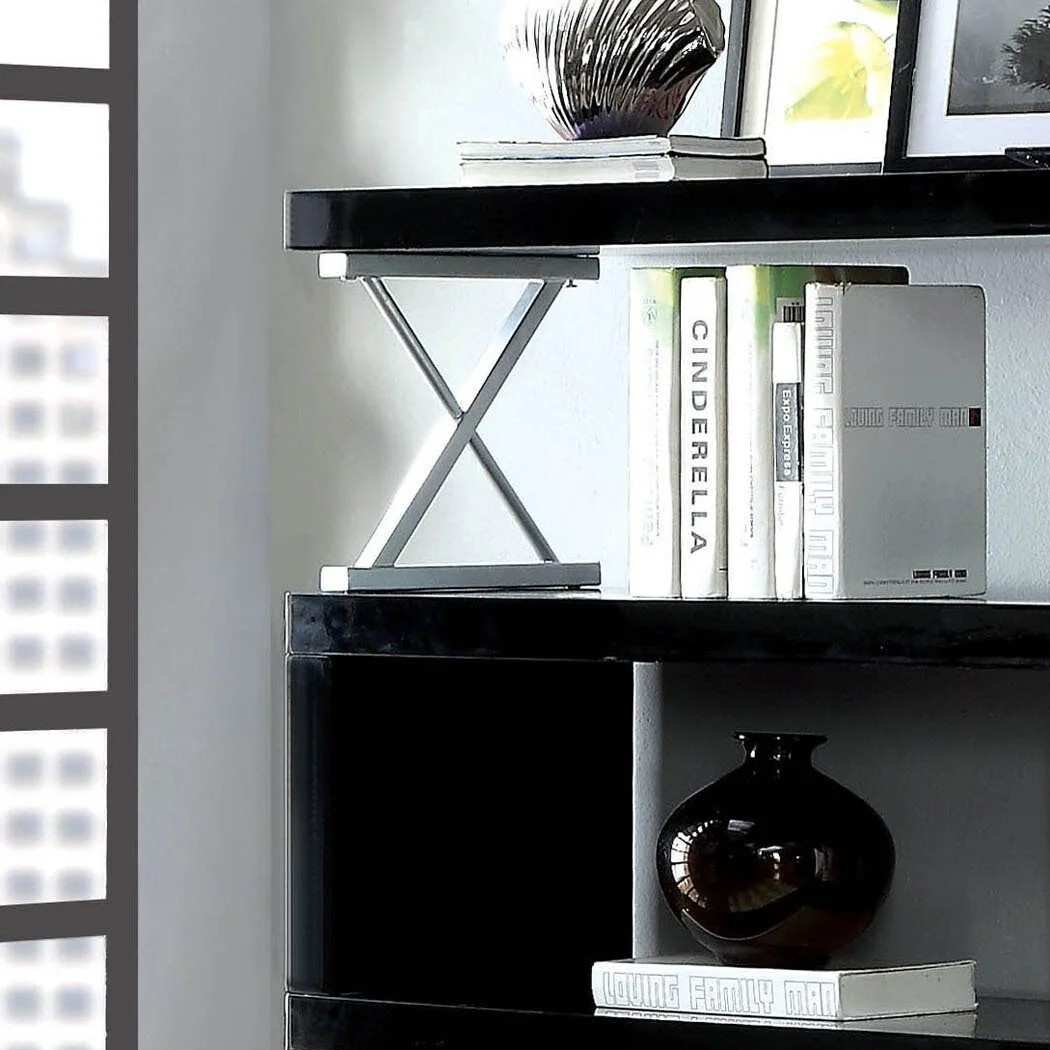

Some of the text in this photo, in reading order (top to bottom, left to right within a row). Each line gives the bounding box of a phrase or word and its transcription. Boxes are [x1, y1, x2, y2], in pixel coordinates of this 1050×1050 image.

[781, 389, 792, 422] Expo
[690, 319, 709, 554] CINDERELLA
[781, 425, 792, 477] Express
[808, 407, 834, 516] FAMILY
[806, 529, 834, 594] MAN
[603, 971, 837, 1017] LOVING FAMILY MAN
